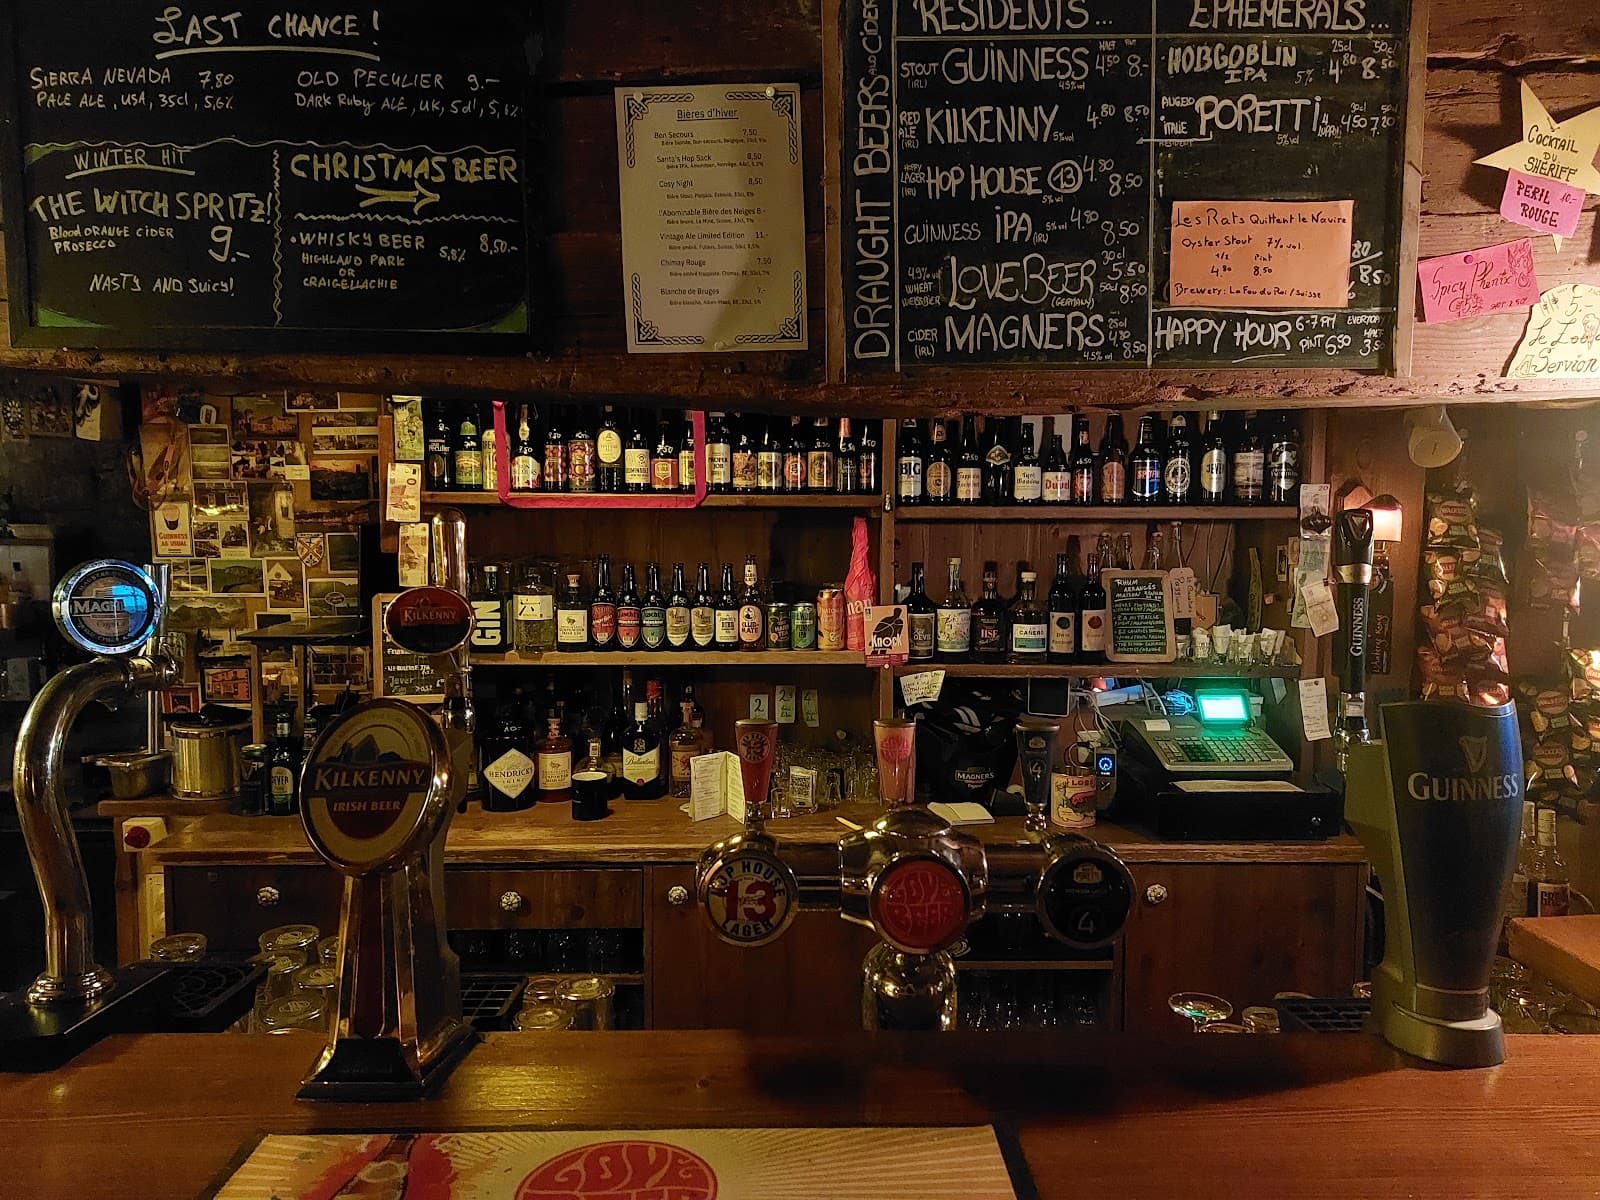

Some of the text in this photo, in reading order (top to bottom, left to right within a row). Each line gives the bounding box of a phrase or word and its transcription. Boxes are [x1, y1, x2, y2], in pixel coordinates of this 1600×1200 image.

[152, 6, 243, 45] LAST
[267, 12, 360, 38] CHANCE
[1167, 39, 1297, 75] HOBGOBLIN
[30, 67, 235, 91] SIERRA NEVADA 7.80
[297, 68, 445, 90] OLD PECULIER
[900, 62, 940, 78] STOUT
[1225, 66, 1268, 84] IPA
[1295, 67, 1315, 87] 5%
[36, 91, 71, 111] PALE
[294, 92, 332, 109] DARK
[338, 93, 377, 117] Ruby
[677, 109, 738, 119] Bières d'hiver
[899, 111, 921, 125] RED
[925, 100, 1060, 145] KILKENNY
[853, 74, 891, 177] BEERS
[898, 126, 918, 138] ALE
[1526, 124, 1579, 154] COCKTAIL
[74, 149, 148, 170] WINTER
[290, 152, 519, 184] CHRISTMAS BEER
[1542, 151, 1559, 164] DU
[1523, 156, 1579, 184] SHERIFF
[926, 165, 965, 200] HOP
[970, 163, 1043, 201] HOUSE
[1516, 179, 1551, 206] PERIL
[29, 190, 87, 222] THE
[93, 187, 169, 218] WITCH
[1175, 208, 1348, 229] Les Rats Quittent le Navire
[1520, 202, 1559, 229] ROUGE
[48, 224, 131, 241] Blood ORANGE
[299, 231, 426, 250] WHISKY BEER
[685, 232, 697, 240] Ale
[697, 231, 722, 240] Limited
[722, 231, 745, 239] Edition
[1181, 235, 1221, 250] Oyster
[1224, 234, 1253, 247] Stout
[54, 239, 117, 254] PROSECCO
[301, 252, 405, 267] HIGHLAND PARK
[660, 258, 707, 268] Chimay Rouge
[89, 272, 184, 293] NASTY AND
[338, 267, 356, 278] OR
[853, 189, 893, 359] DRAUGHT
[302, 276, 399, 291] CRAIGELLACHIE
[689, 287, 697, 295] de
[904, 281, 934, 295] WHEAT
[1259, 284, 1273, 296] du
[1430, 266, 1468, 306] Spicy
[944, 310, 1105, 354] MAGNERS
[1155, 316, 1293, 354] HAPPY HOUR
[900, 462, 921, 475] BIG
[158, 532, 188, 540] GUINNESS
[404, 609, 457, 622] KILKENNY
[471, 602, 502, 646] GIN
[1350, 596, 1364, 657] GUINNESS
[754, 698, 764, 712] 2
[314, 768, 424, 791] KILKENNY
[956, 771, 994, 780] MAGNERS
[1407, 772, 1519, 801] GUINNESS
[333, 800, 400, 812] IRISH BEER
[726, 880, 776, 920] 13
[722, 917, 774, 938] LAGER
